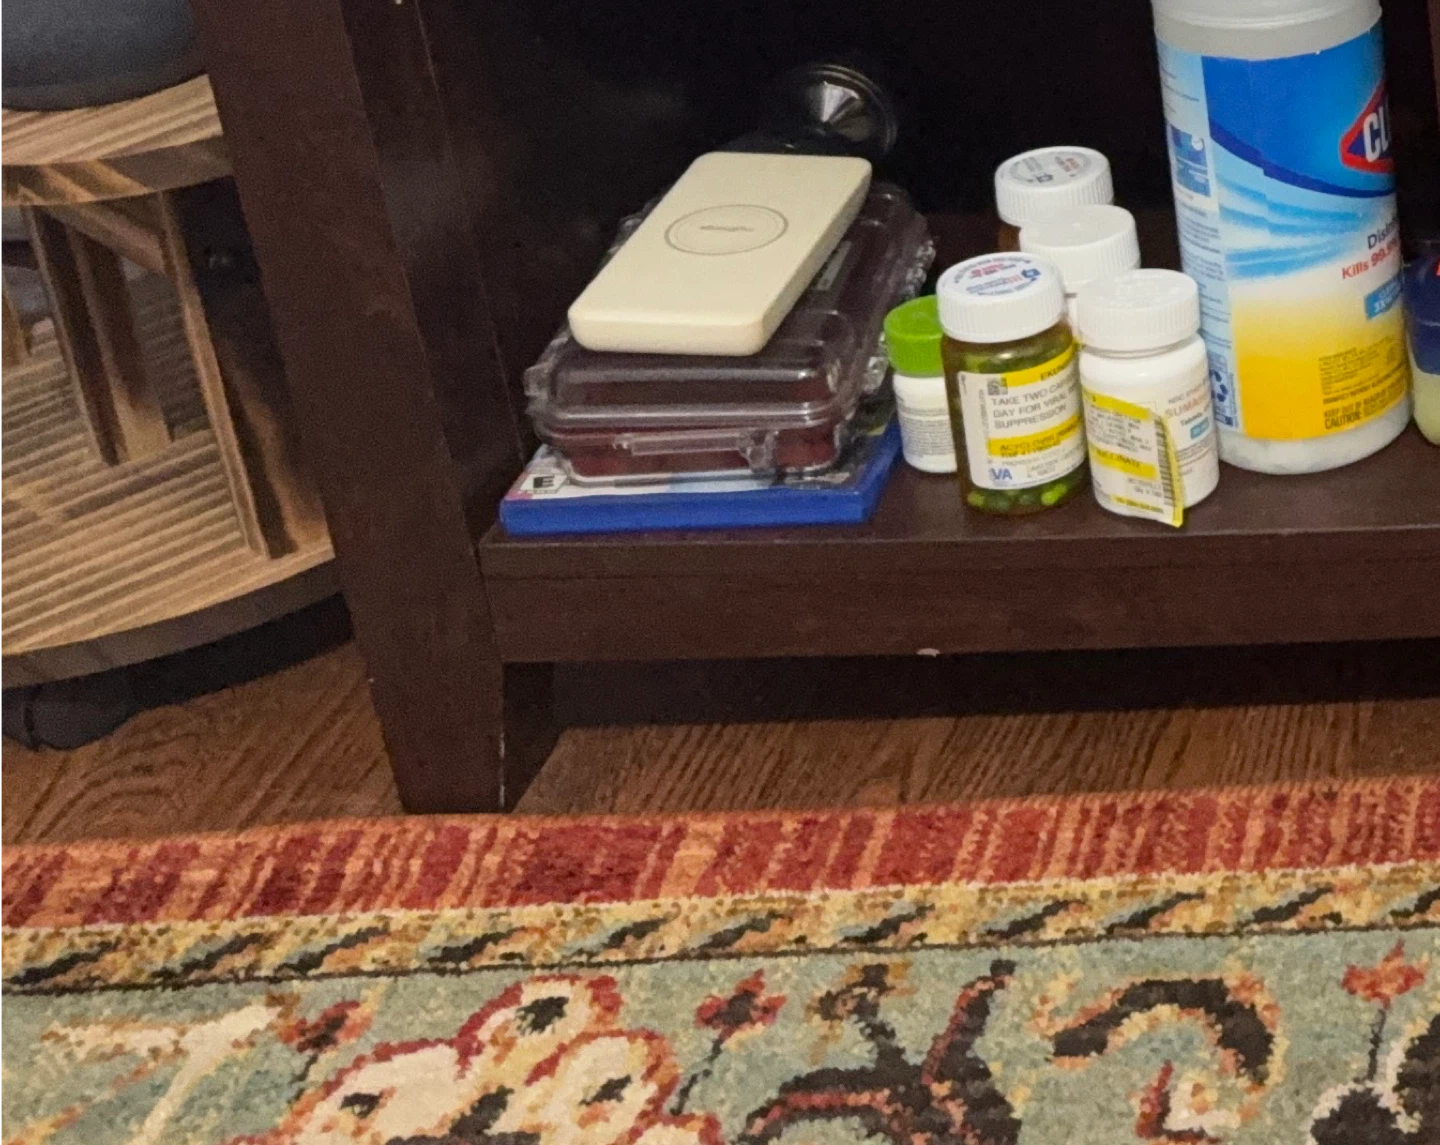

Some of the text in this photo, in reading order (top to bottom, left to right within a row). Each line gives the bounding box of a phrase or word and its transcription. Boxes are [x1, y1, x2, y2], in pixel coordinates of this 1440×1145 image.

[1342, 260, 1369, 279] Kills
[990, 467, 1013, 481] VA
[533, 475, 556, 489] E
